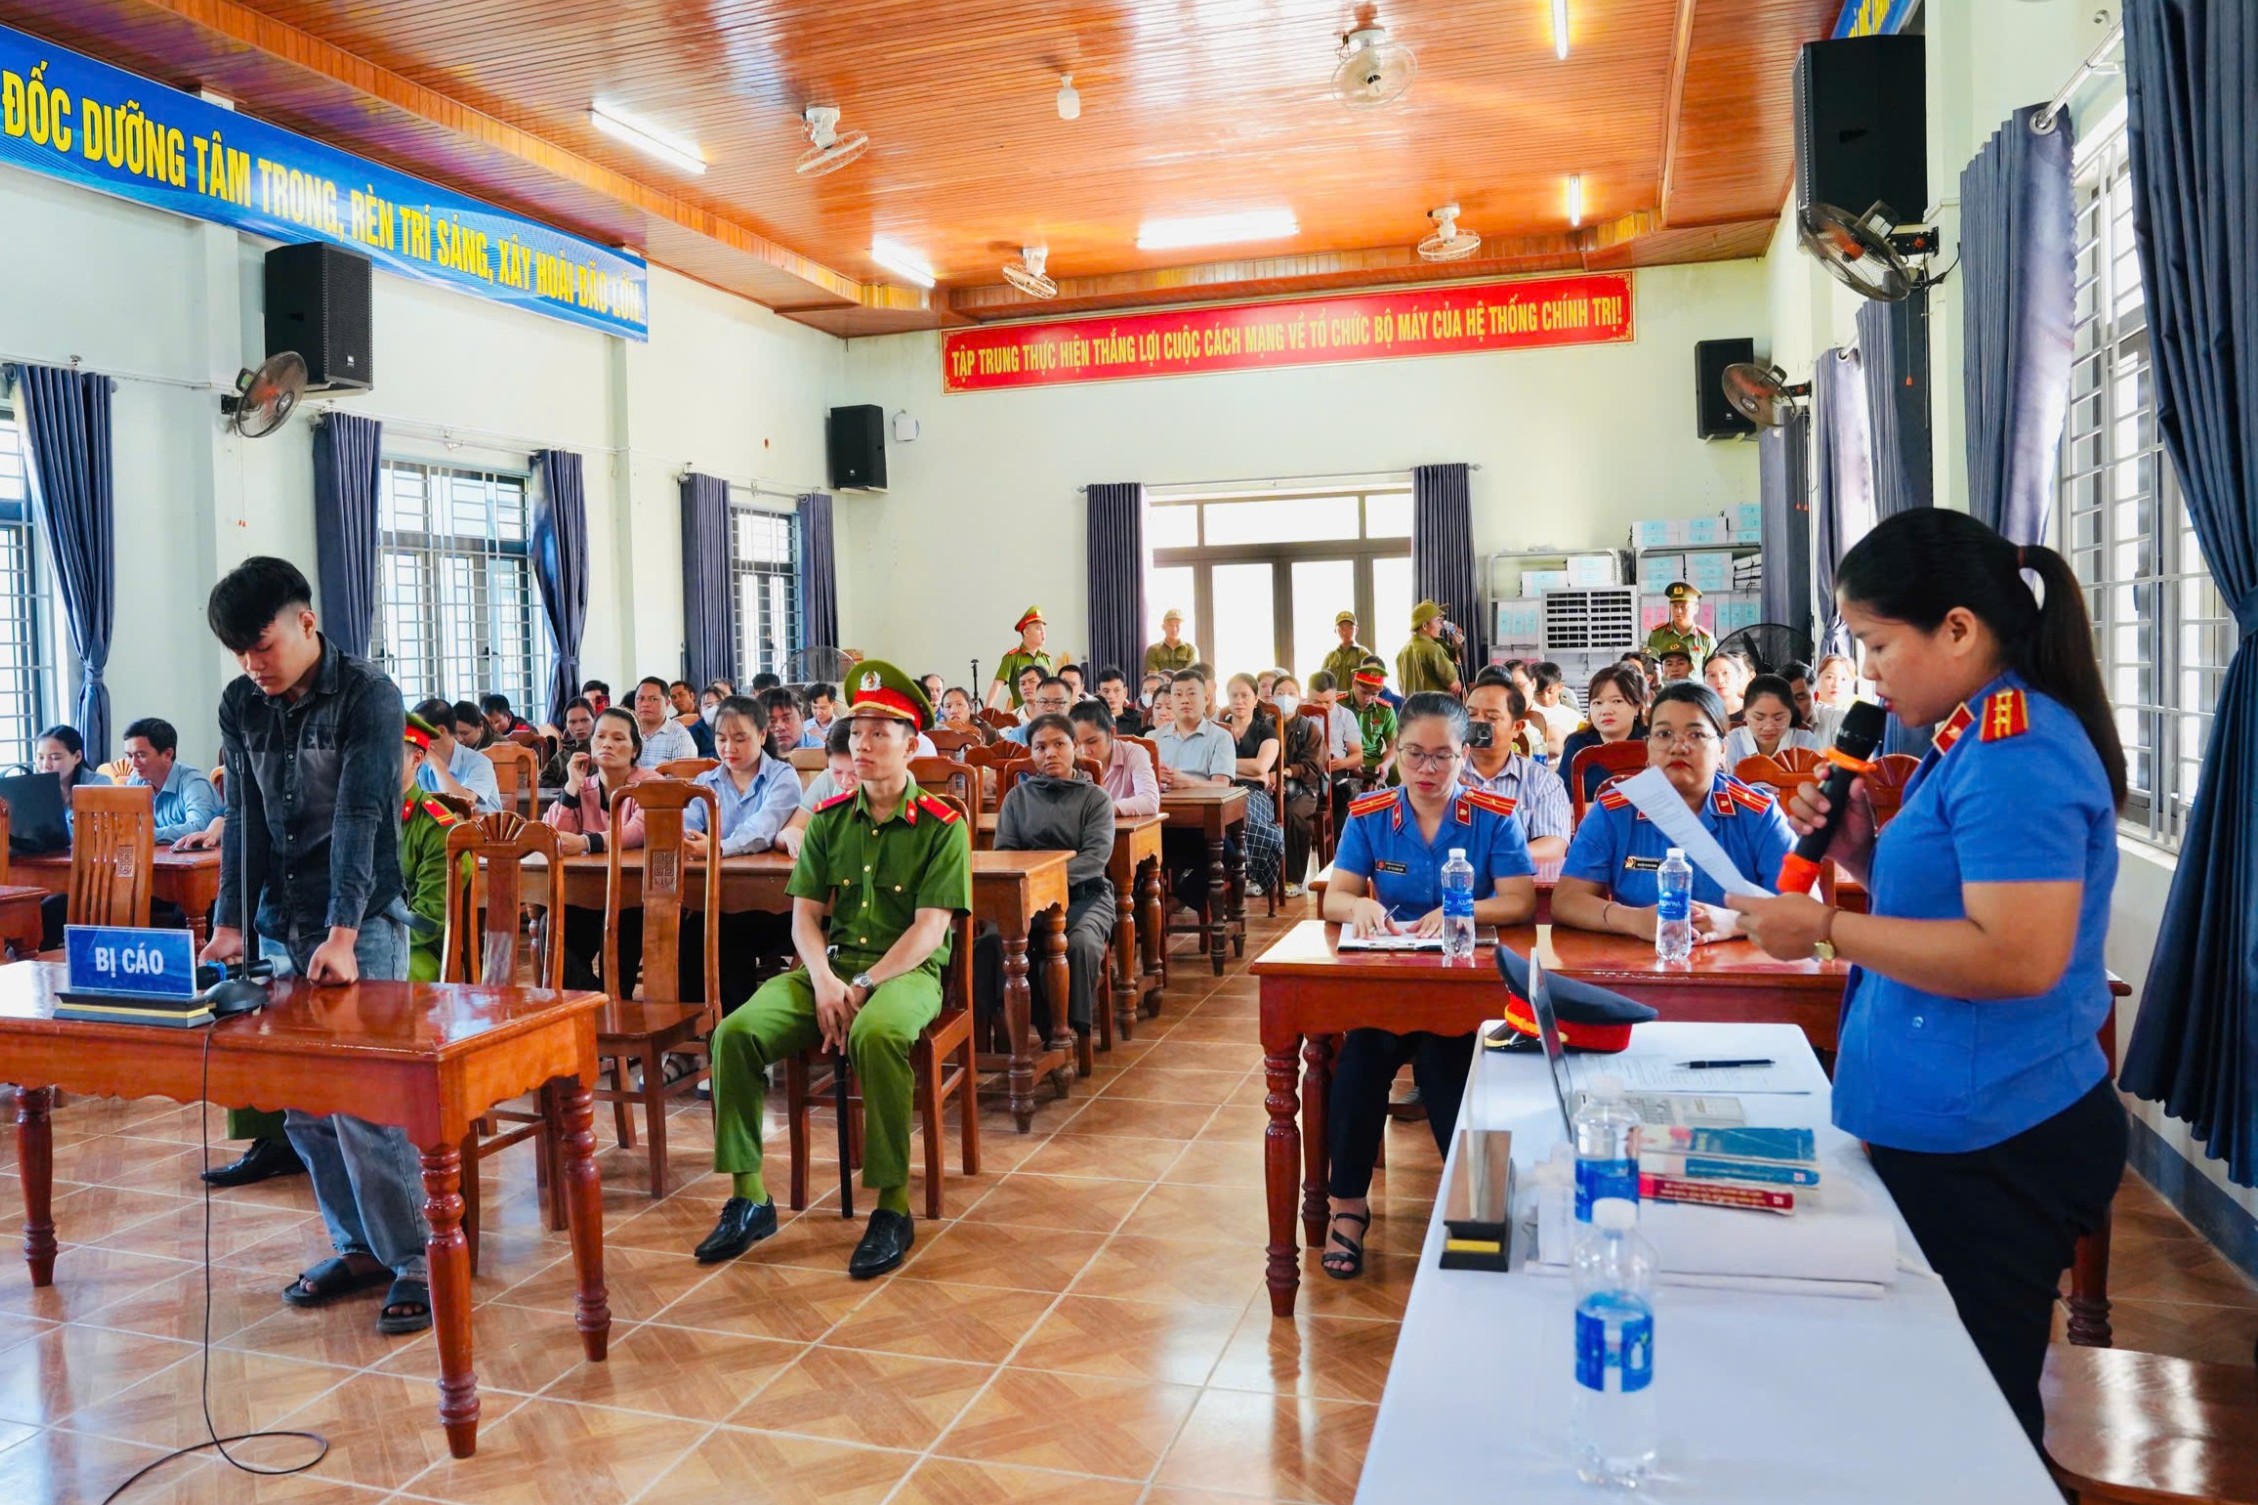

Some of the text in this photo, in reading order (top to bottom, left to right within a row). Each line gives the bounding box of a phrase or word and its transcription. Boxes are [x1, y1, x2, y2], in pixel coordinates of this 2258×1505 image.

[2, 60, 72, 153] ĐỐC
[82, 99, 186, 188] DƯỠNG
[193, 130, 251, 208] TÂM
[351, 183, 394, 251] RÈN
[399, 204, 431, 262] TRÍ
[437, 213, 494, 286] SÁNG,
[498, 233, 531, 291] XÂY
[536, 250, 574, 304] HOÀI
[577, 259, 608, 314] BÃO
[952, 292, 1623, 383] TẬP TRUNG THỰC HIỆN THẮNG LỢI CUỘC CÁCH MẠNG VỀ TỔ CHỨC BỘ MÁY CỦA HỆ THỐNG CHÍNH TRỊ!
[95, 942, 164, 978] BỊ CÁO
